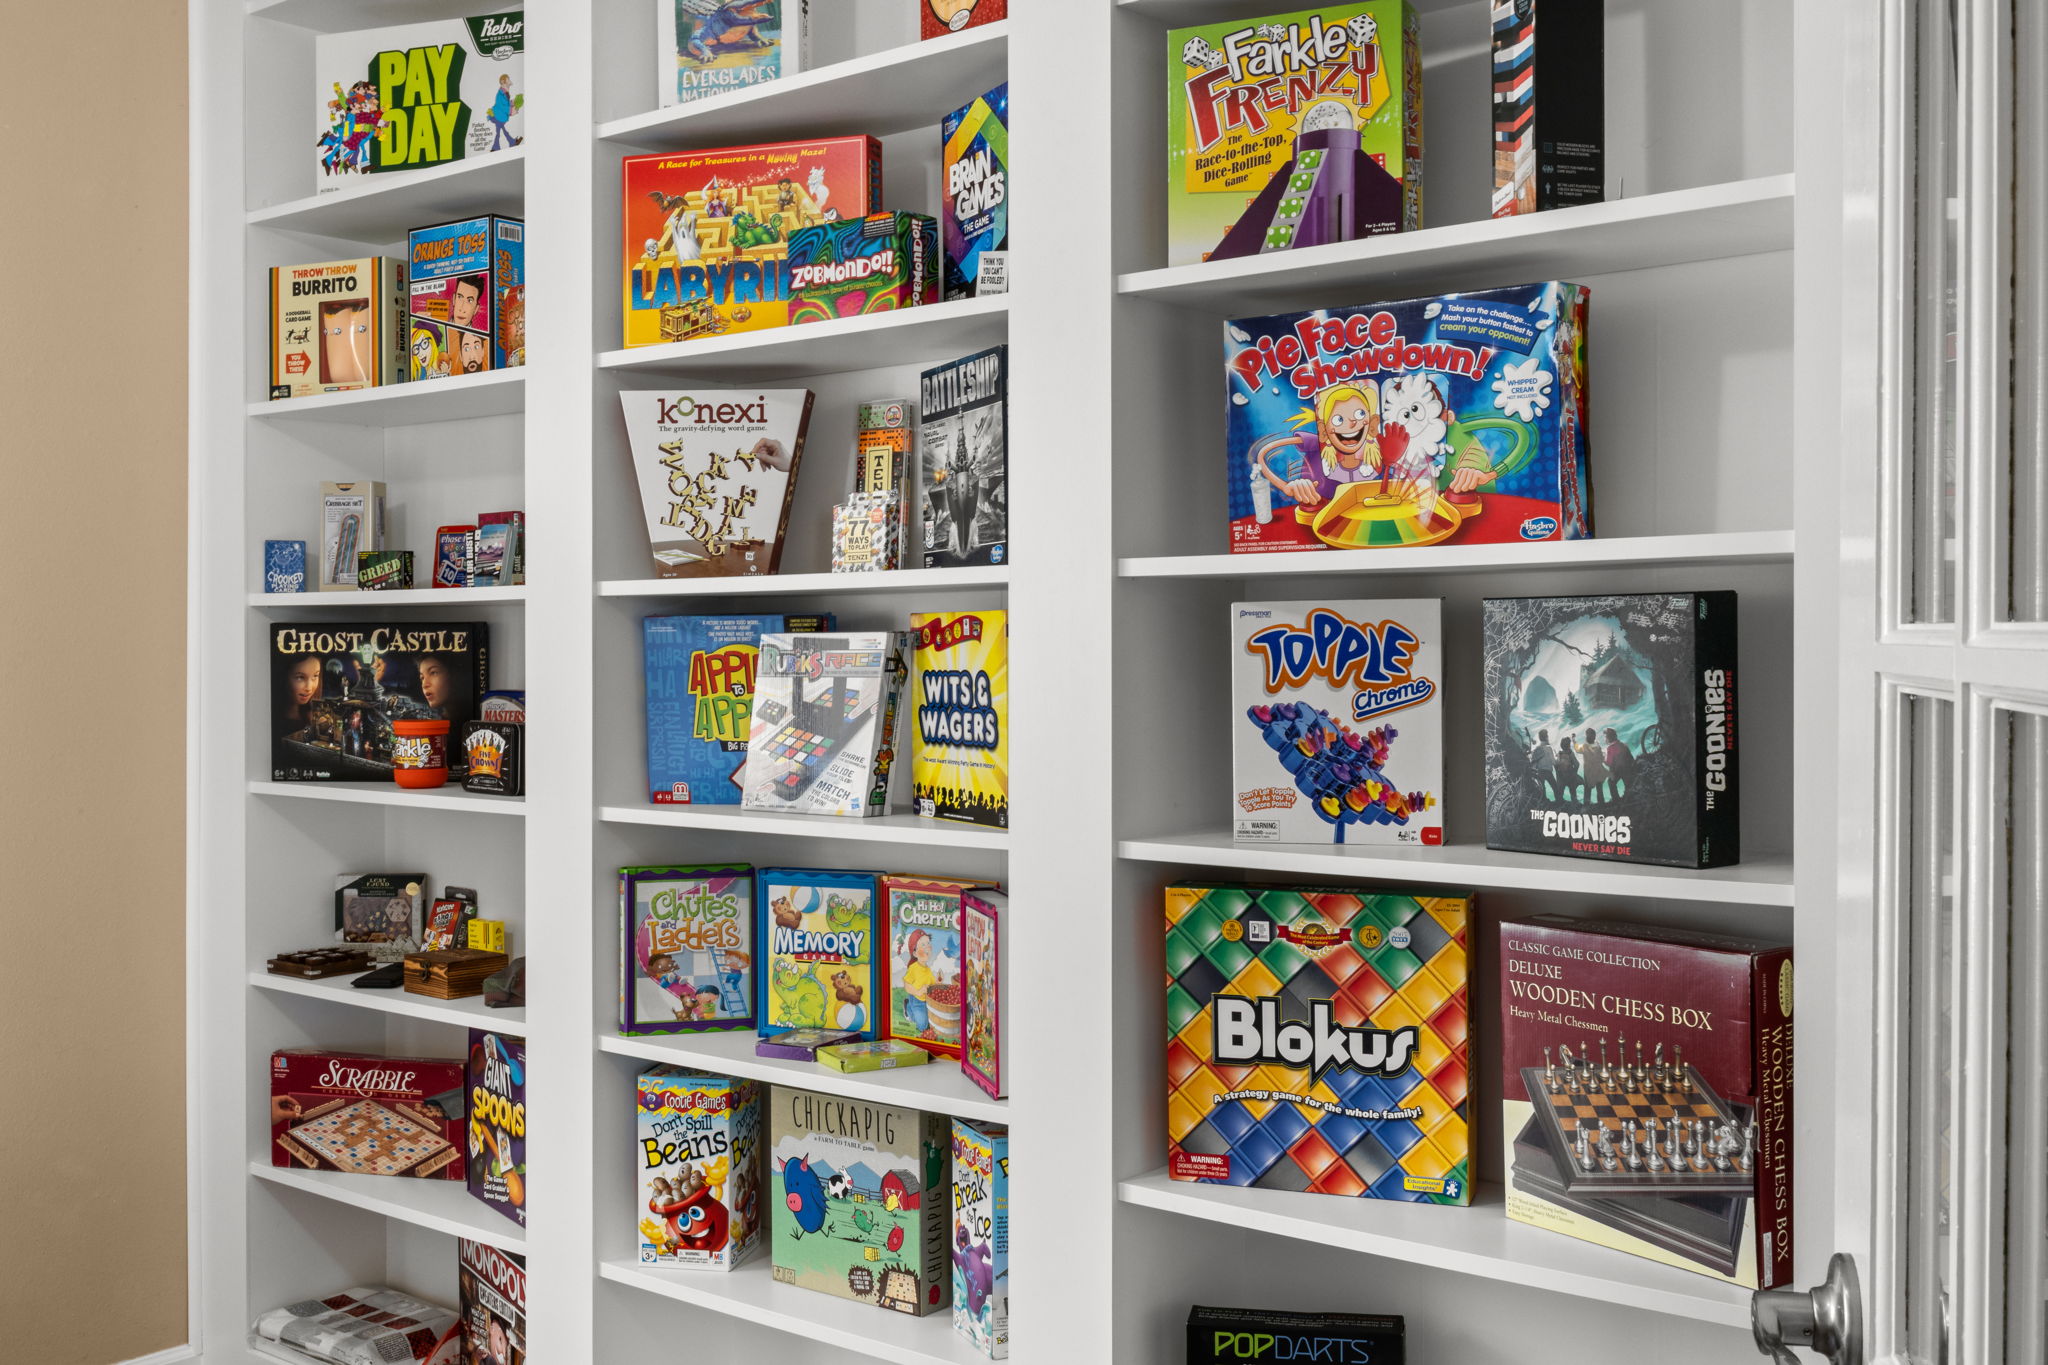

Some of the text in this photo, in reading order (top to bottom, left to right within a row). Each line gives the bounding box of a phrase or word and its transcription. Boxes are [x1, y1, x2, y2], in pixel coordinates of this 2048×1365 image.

[480, 17, 524, 37] Retro
[1224, 15, 1347, 82] Farkle
[379, 44, 457, 107] PAY
[682, 66, 776, 88] EVERGLADES
[1186, 43, 1380, 154] FRENZY
[380, 102, 462, 167] DAY
[1228, 135, 1243, 145] The
[658, 147, 827, 169] A Race for Treasures Maze!
[1195, 135, 1287, 171] Race-to-the-Top,
[1204, 152, 1272, 183] Dice-Rolling
[1225, 174, 1249, 187] Game
[956, 172, 1005, 222] GAMES
[963, 214, 990, 233] THE GAME
[413, 232, 486, 263] ORANGE TOSS
[292, 264, 357, 279] THROW THROW
[498, 249, 513, 288] TOSS
[292, 276, 358, 297] BURRITO
[632, 255, 788, 311] LABYRI
[1448, 305, 1465, 313] Take
[1476, 306, 1488, 315] the
[1440, 323, 1531, 346] cream your opponent!
[1441, 313, 1534, 337] Mash your button fastest to
[1234, 311, 1397, 392] Pie Face
[1291, 336, 1494, 400] Showdown!
[922, 353, 999, 417] BATTLESHIP
[1507, 377, 1538, 387] WHIPPED
[1511, 386, 1534, 394] CREAM
[657, 395, 768, 424] konexi
[673, 425, 726, 433] gravity-defying
[325, 500, 351, 508] CRIBBAGE
[849, 520, 869, 537] 77
[1524, 519, 1555, 532] Hasbro
[847, 536, 870, 545] WAYS
[855, 542, 869, 550] PLAY
[267, 571, 304, 585] CROOKED
[358, 558, 402, 583] GREED
[277, 627, 469, 655] GHOST CASTLE
[1250, 612, 1417, 685] TOPPLE
[691, 650, 759, 694] APPL
[825, 652, 882, 669] RACE
[925, 675, 989, 707] WITS &
[1355, 679, 1431, 710] Chrome
[484, 710, 526, 722] MASTERS
[921, 708, 997, 745] WAGERS
[394, 738, 432, 758] arkle
[479, 751, 491, 759] FIVE
[839, 751, 866, 764] SHAKE
[830, 764, 855, 778] SLIDE
[816, 781, 851, 801] MATCH
[1240, 789, 1259, 800] Don't
[1272, 787, 1294, 795] Topple
[1240, 796, 1261, 806] Topple
[1573, 842, 1631, 855] NEVER SAY DIE
[651, 885, 738, 923] Chutes
[917, 900, 944, 913] Hi Ho!
[647, 917, 740, 954] Ladders
[661, 919, 677, 930] and
[774, 927, 864, 956] MEMORY
[1508, 939, 1661, 972] CLASSIC GAME COLLECTION
[1509, 958, 1563, 980] DELUXE
[1509, 979, 1713, 1031] WOODEN CHESS BOX
[1510, 1005, 1609, 1033] Heavy Metal Chessmen
[1216, 999, 1415, 1075] Blokus
[319, 1059, 416, 1098] SCRABBLE
[484, 1059, 512, 1099] GIANT
[665, 1091, 726, 1111] Cootie Games
[1213, 1089, 1422, 1120] A strategy game for the whole family!
[1760, 1028, 1771, 1169] Heavy Metal Chessmen
[472, 1085, 525, 1138] SPOONS
[792, 1095, 895, 1145] CHICKAPIG
[651, 1113, 713, 1138] Don't Spill
[674, 1129, 688, 1141] the
[640, 1129, 728, 1170] Beans
[818, 1135, 862, 1149] FARM TO TABLE
[1772, 1025, 1789, 1262] WOODEN CHESS BOX
[1190, 1155, 1224, 1165] WARNING:
[952, 1169, 987, 1212] Break
[1407, 1178, 1441, 1188] Educational
[972, 1207, 991, 1240] Ice
[927, 1191, 942, 1285] CHICKAPIG
[1214, 1331, 1369, 1364] POPDARTS
